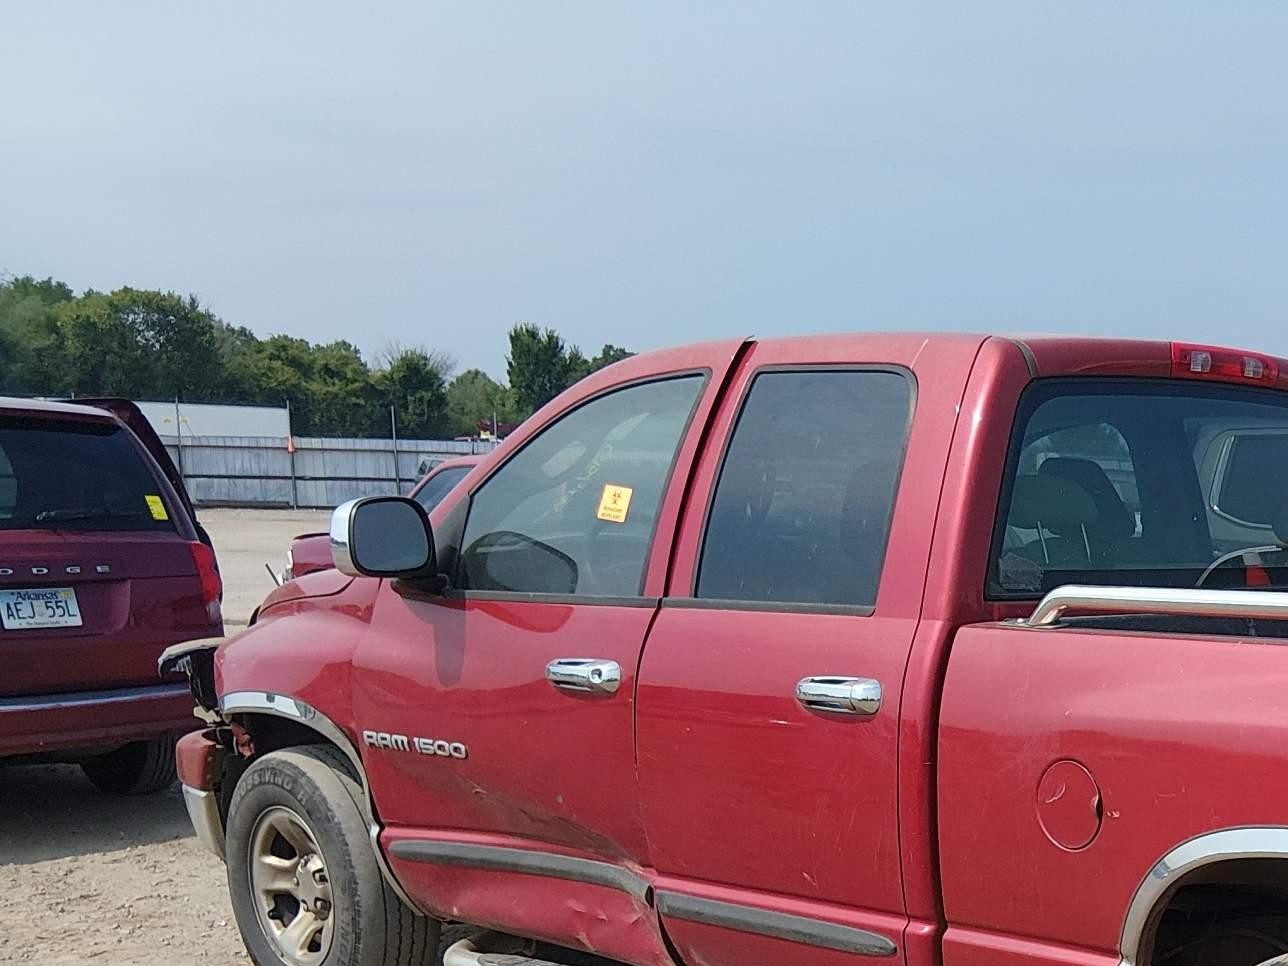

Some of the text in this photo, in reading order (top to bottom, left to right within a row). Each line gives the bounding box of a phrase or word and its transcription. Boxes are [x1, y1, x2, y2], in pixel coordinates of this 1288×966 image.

[15, 591, 59, 602] Arkansas
[6, 599, 77, 621] AEJ 55L
[363, 730, 468, 760] RAM 1500
